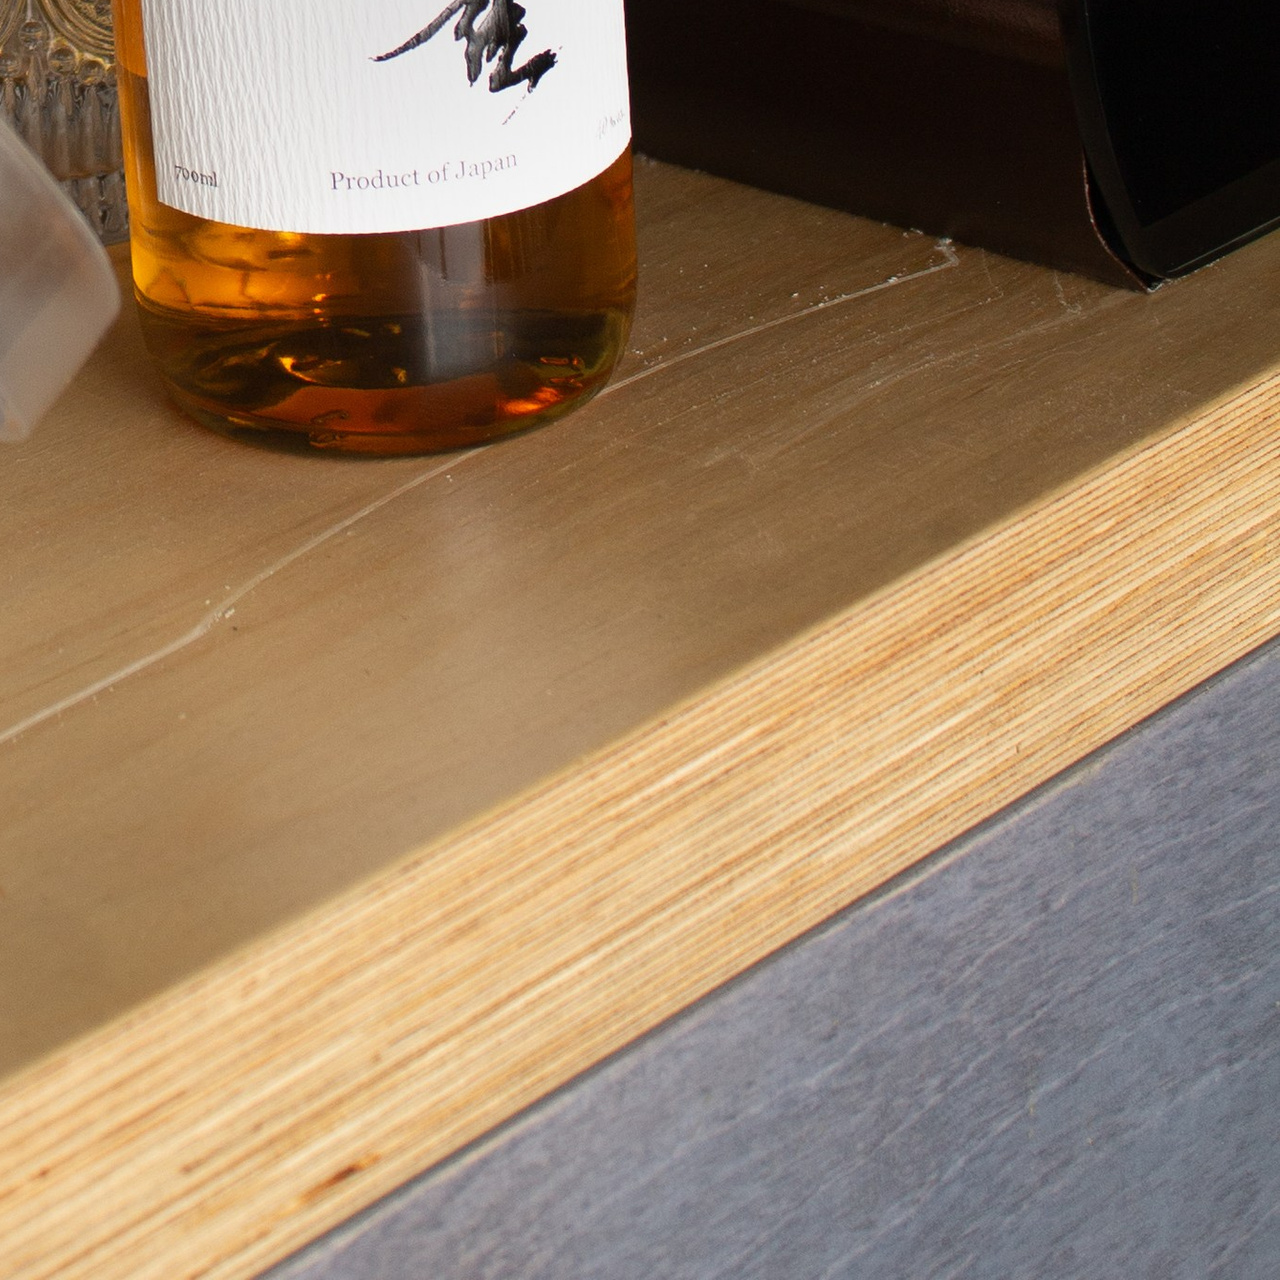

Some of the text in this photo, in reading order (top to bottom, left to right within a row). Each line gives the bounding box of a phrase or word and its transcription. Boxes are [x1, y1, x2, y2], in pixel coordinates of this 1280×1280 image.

[174, 164, 219, 188] 700ml
[330, 153, 518, 191] Product of Japan
